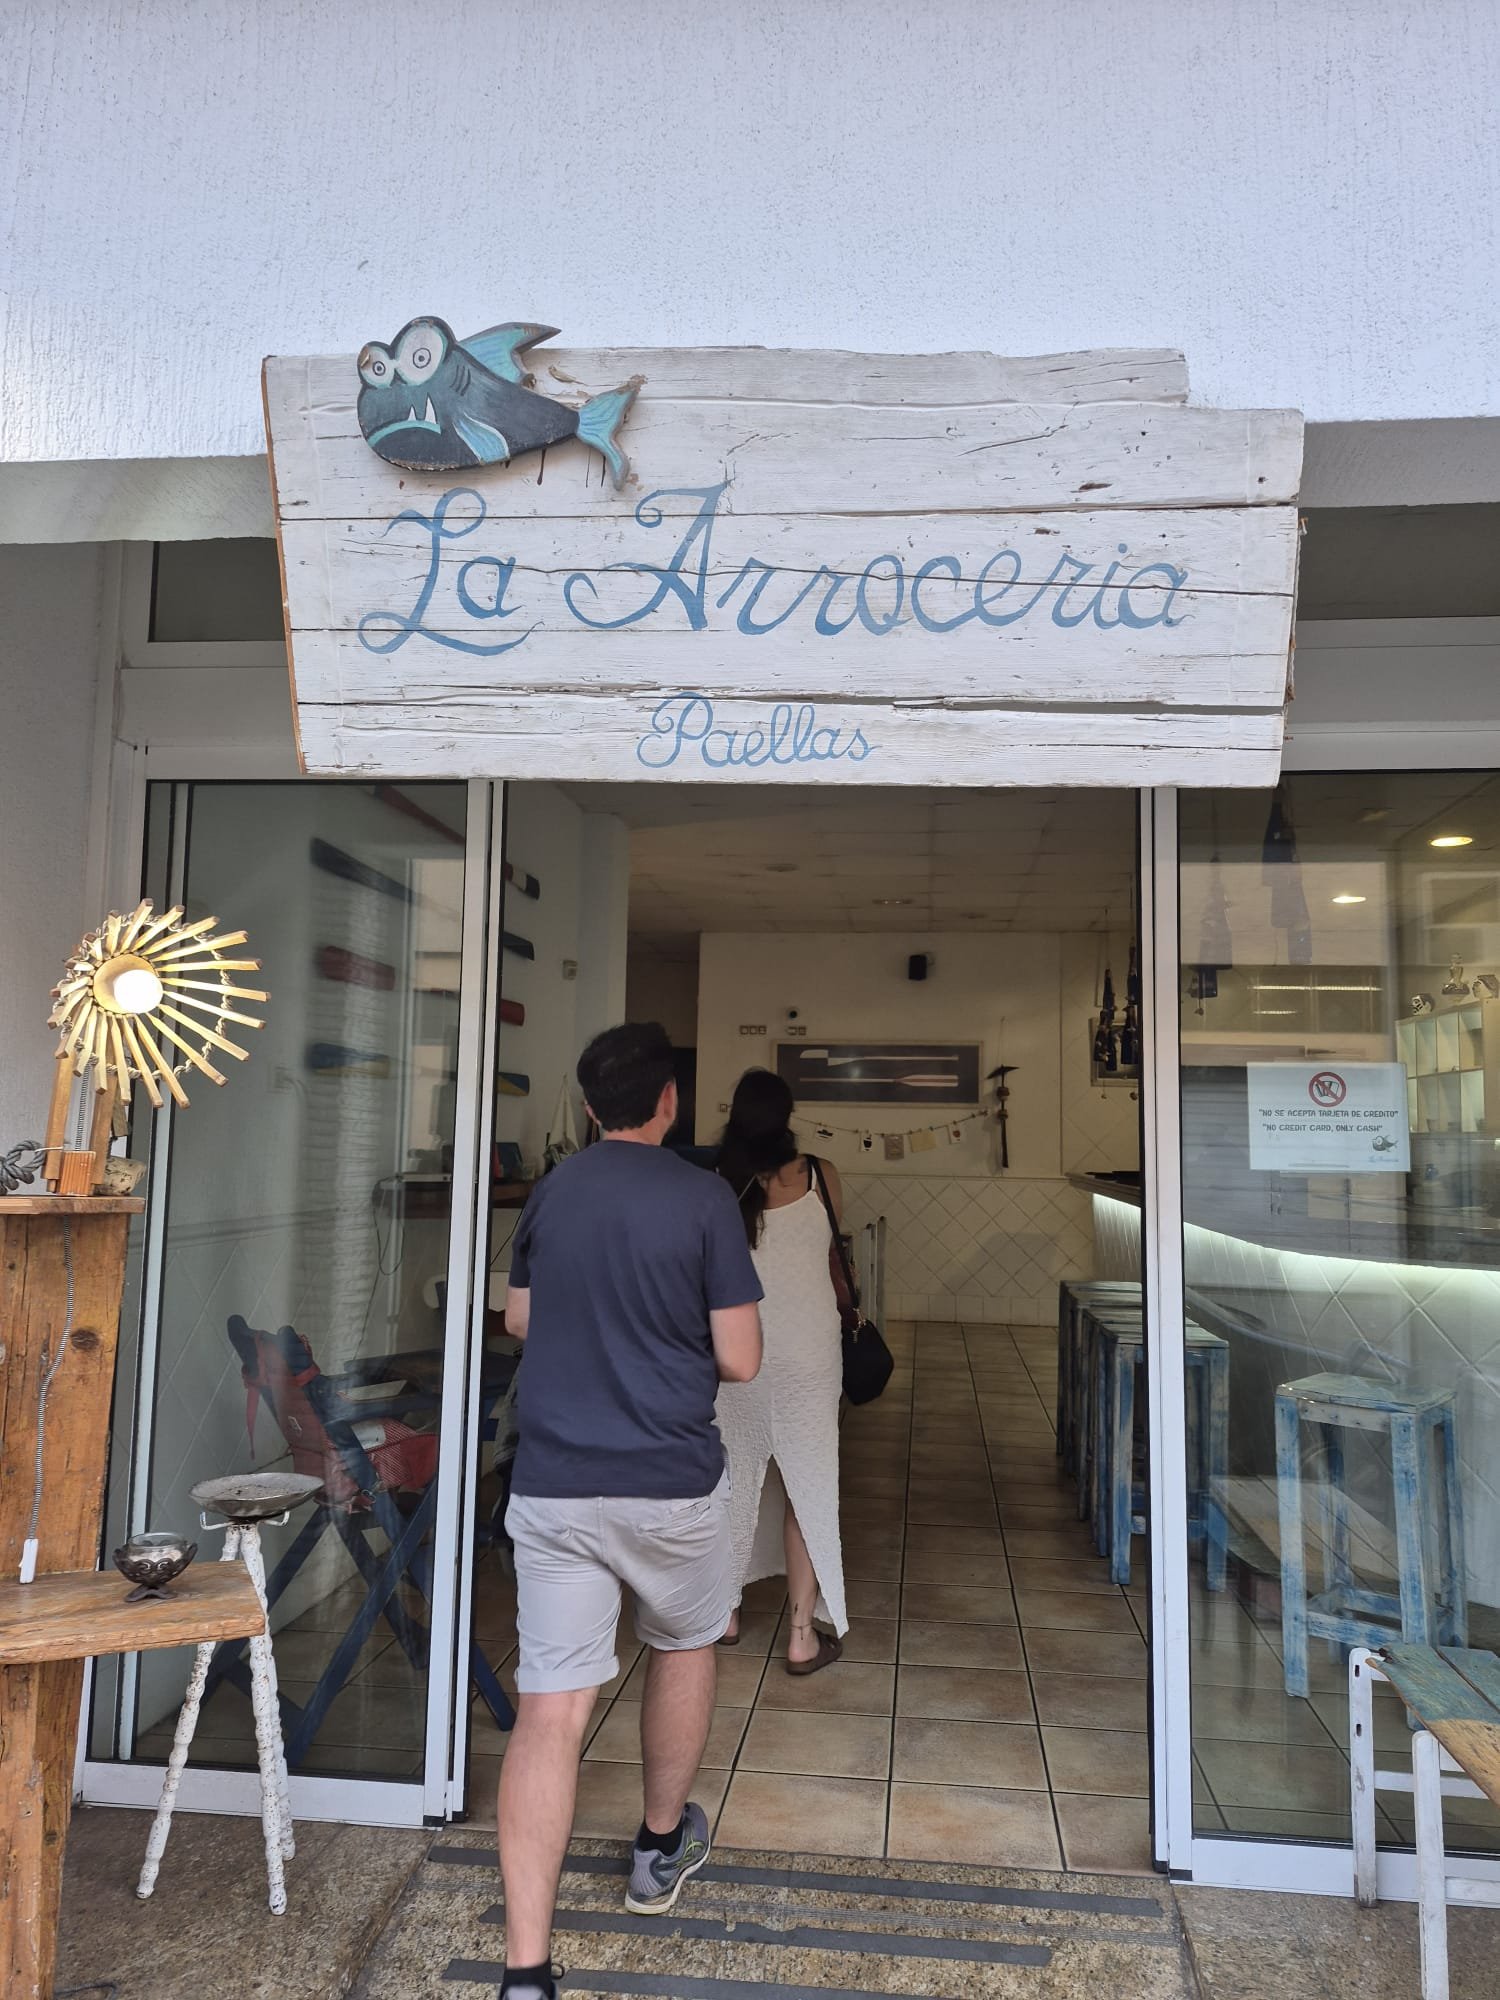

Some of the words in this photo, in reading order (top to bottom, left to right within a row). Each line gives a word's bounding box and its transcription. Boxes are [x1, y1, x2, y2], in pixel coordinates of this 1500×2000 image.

[358, 487, 544, 657] La
[564, 479, 1195, 636] Arroceria
[637, 692, 877, 769] Paellas
[1274, 1109, 1285, 1117] SE
[1287, 1109, 1316, 1117] ACEPTA
[1318, 1109, 1349, 1118] TARJETA
[1351, 1110, 1361, 1118] DE
[1279, 1124, 1306, 1132] CREDIT
[1309, 1124, 1334, 1133] CARD,
[1335, 1124, 1354, 1132] ONLY
